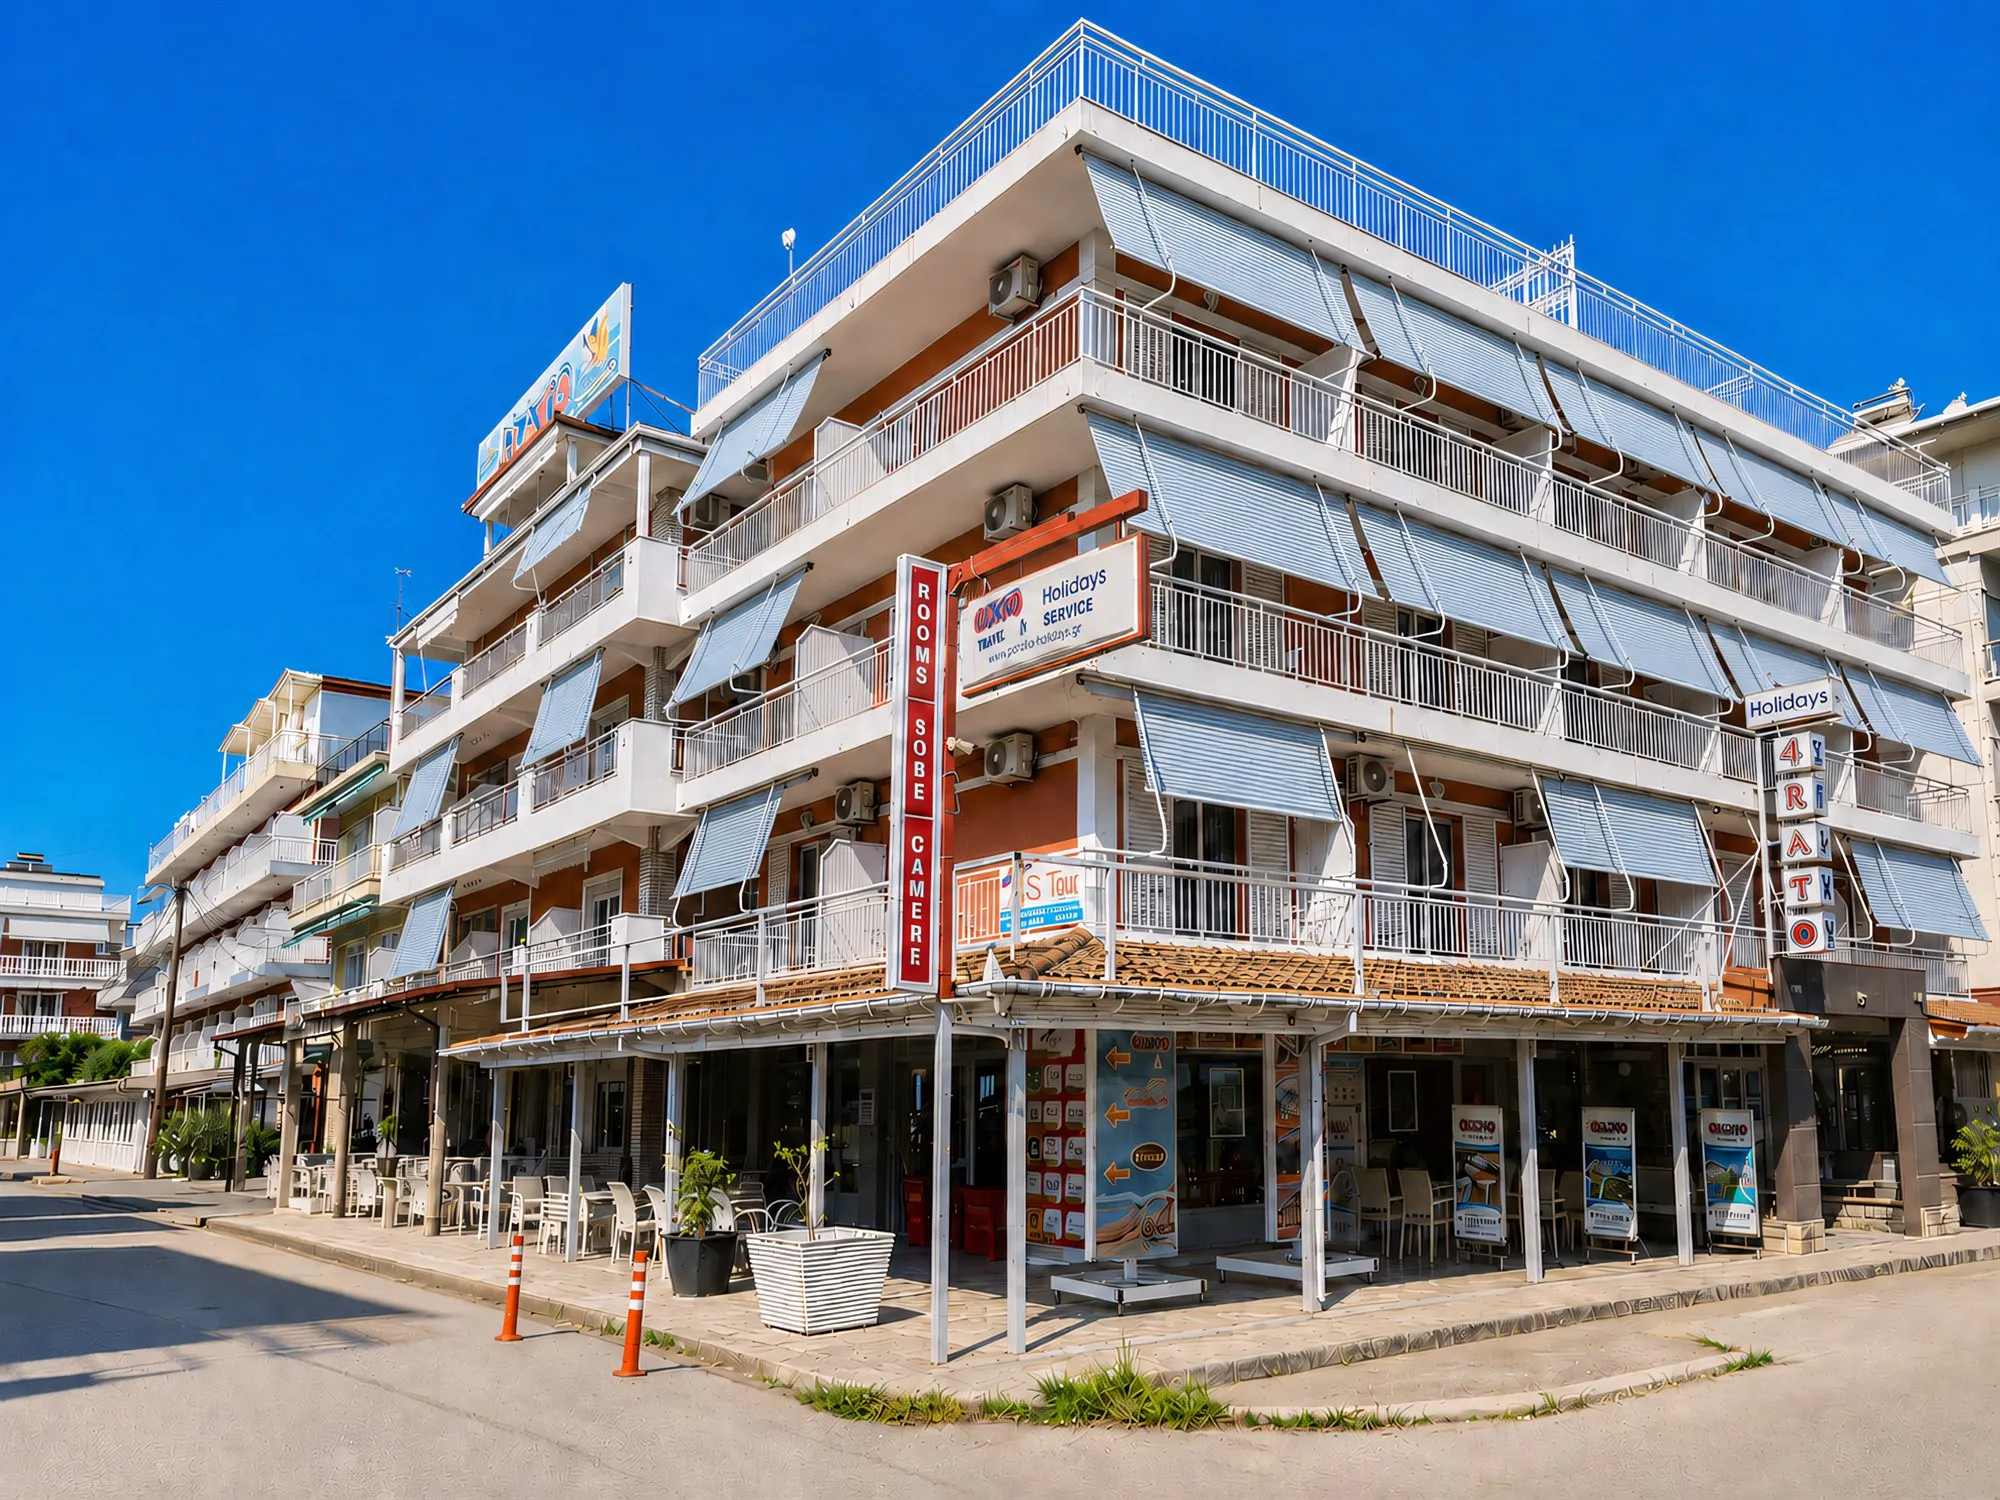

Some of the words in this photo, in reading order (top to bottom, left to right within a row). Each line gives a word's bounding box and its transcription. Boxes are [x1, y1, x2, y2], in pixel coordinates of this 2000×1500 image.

[1042, 568, 1107, 605] Holidays
[1043, 597, 1094, 627] SERVICE
[915, 582, 931, 685] ROOMS
[1750, 690, 1828, 718] Holidays
[913, 718, 926, 801] SOBE
